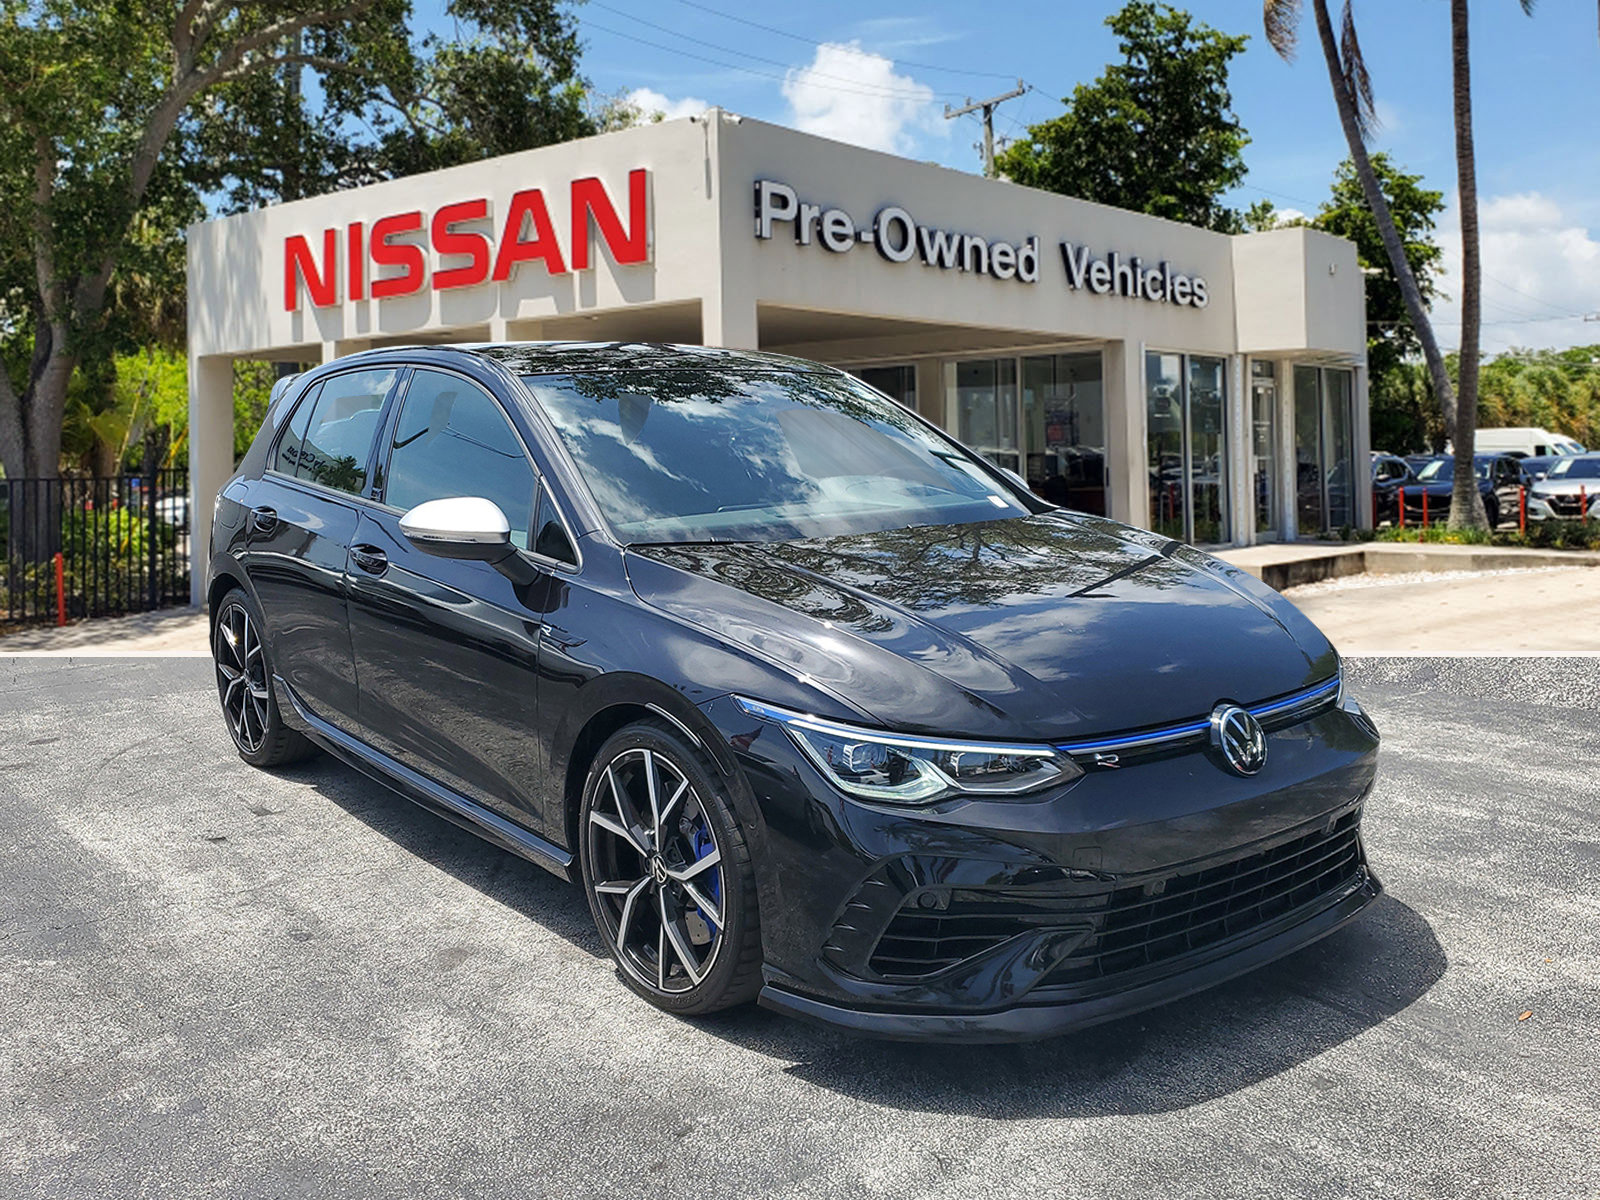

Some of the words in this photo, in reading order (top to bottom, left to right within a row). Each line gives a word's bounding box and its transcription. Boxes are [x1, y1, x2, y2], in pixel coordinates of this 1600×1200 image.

[285, 168, 646, 312] NISSAN
[754, 179, 1040, 283] Pre-Owned
[1059, 242, 1209, 309] Vehicles
